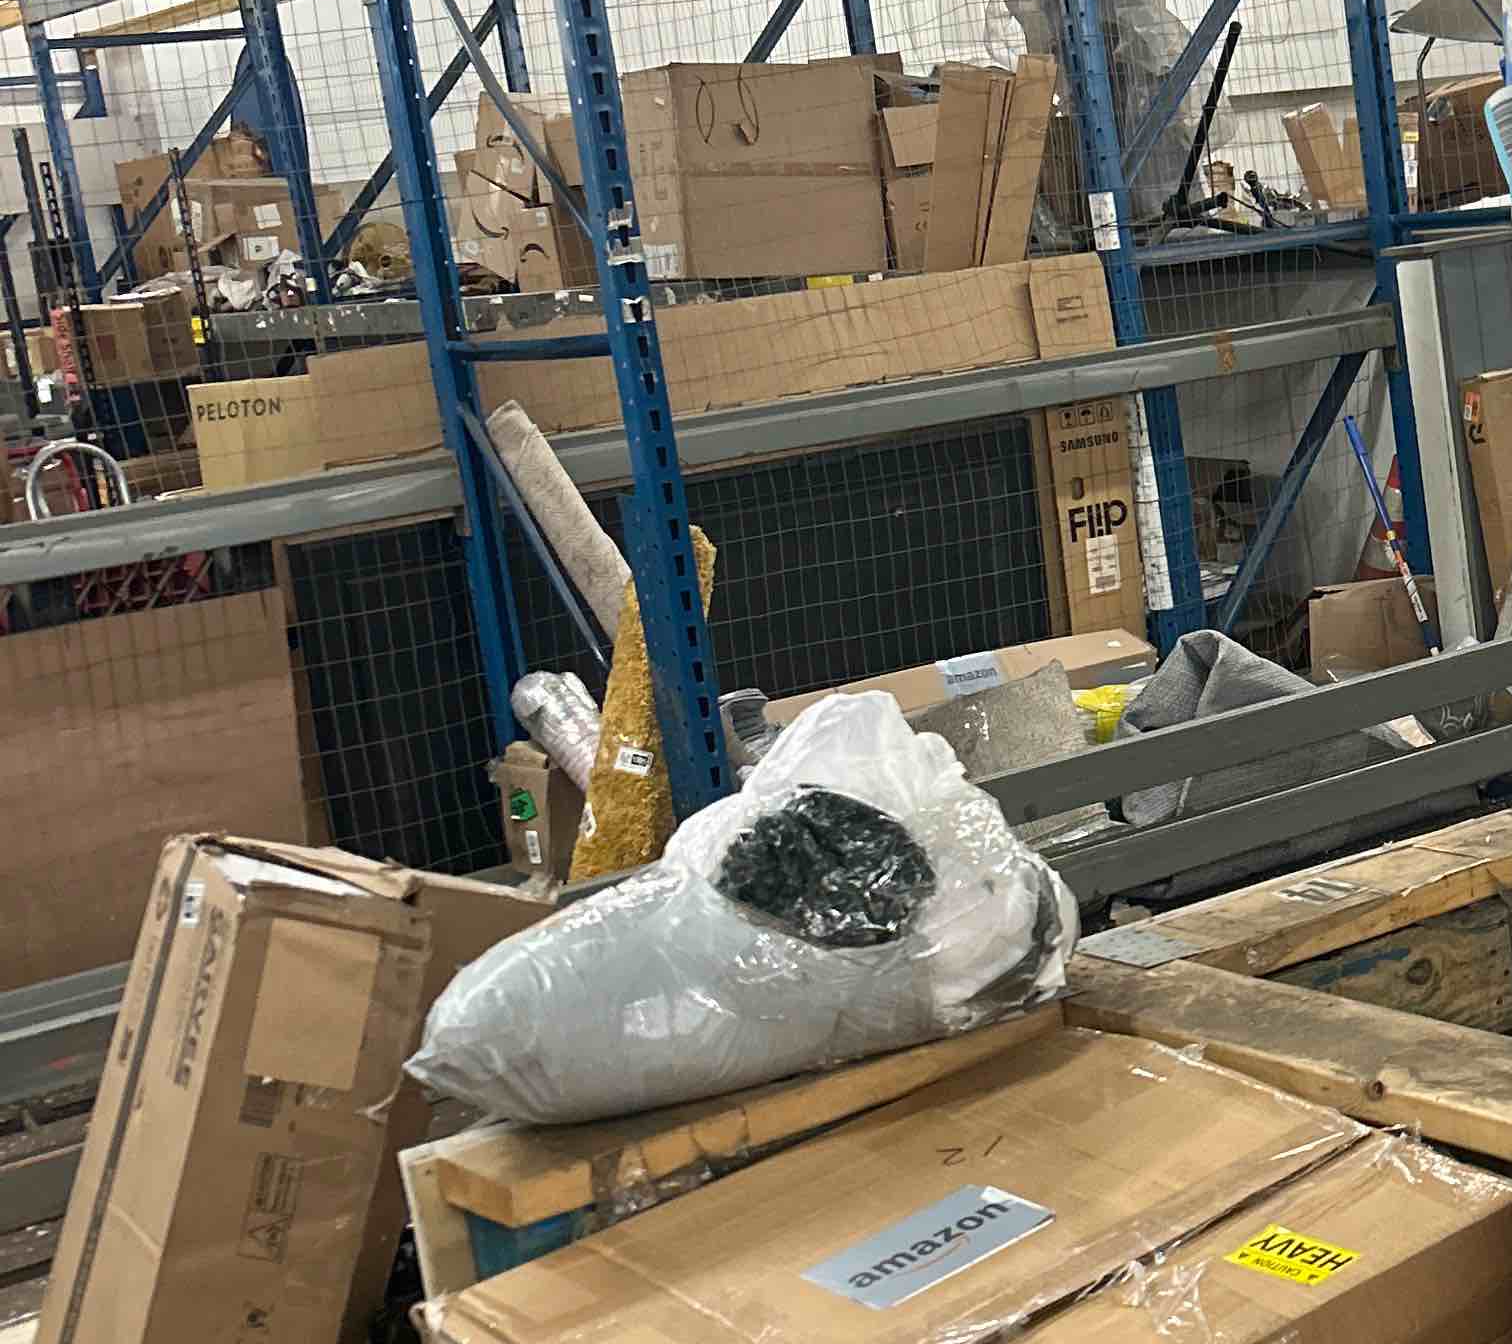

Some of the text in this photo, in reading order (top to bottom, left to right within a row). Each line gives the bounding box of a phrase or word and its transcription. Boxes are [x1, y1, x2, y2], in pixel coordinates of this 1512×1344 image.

[196, 397, 282, 423] PELOTON
[848, 1198, 1010, 1291] amazon
[1249, 1233, 1353, 1272] HEAVY
